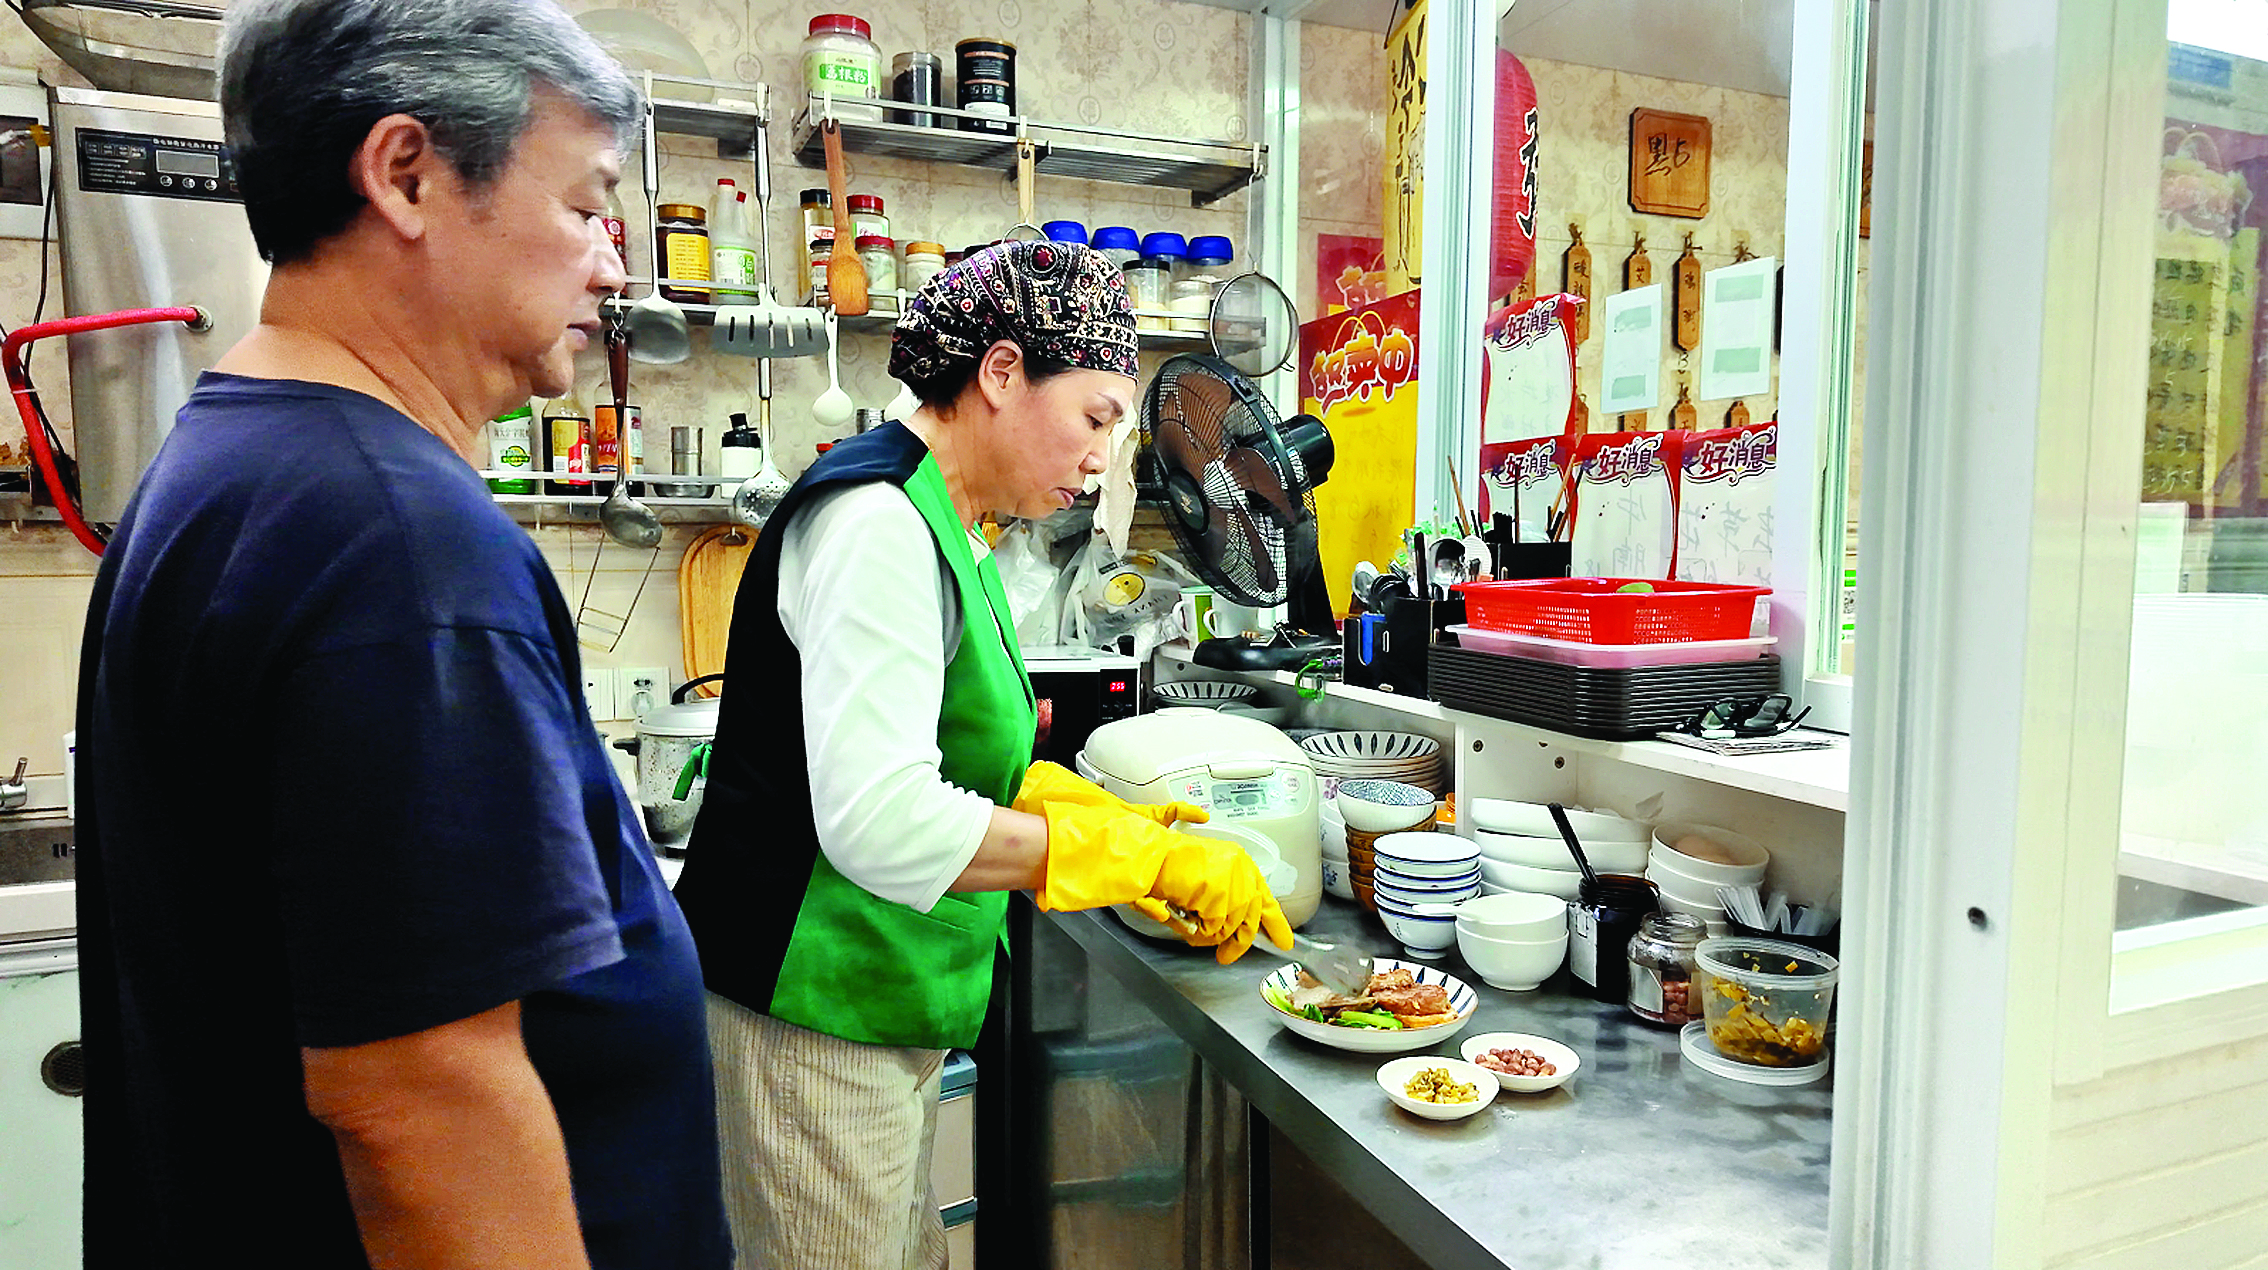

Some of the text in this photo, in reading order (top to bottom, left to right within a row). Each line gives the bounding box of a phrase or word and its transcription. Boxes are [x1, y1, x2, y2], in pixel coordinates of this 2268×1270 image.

[1507, 307, 1551, 344] 好消息
[1506, 450, 1549, 480] 好消息
[1598, 444, 1652, 476] 好消息
[1699, 438, 1766, 475] 好消息
